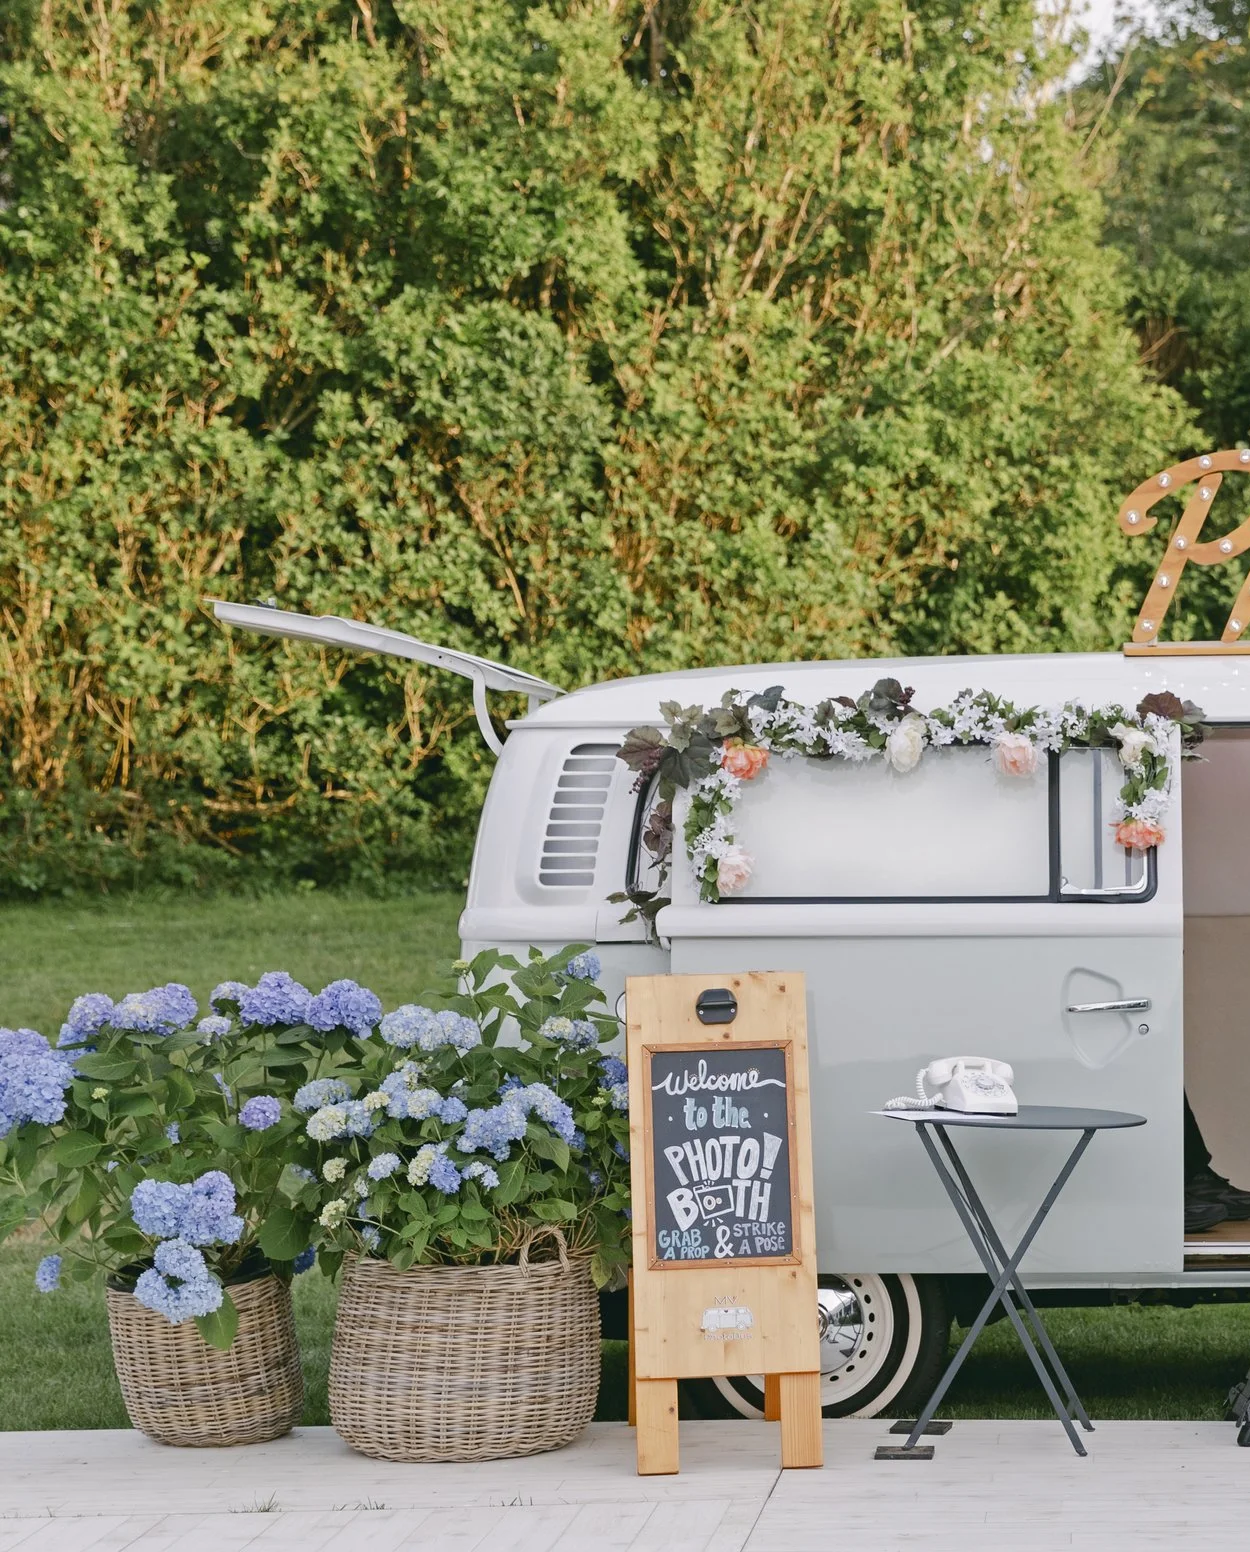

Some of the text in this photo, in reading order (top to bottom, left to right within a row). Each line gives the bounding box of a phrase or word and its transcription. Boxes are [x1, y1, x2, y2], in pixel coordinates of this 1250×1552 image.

[651, 1059, 786, 1096] Welcome
[684, 1095, 751, 1131] to the
[663, 1132, 783, 1186] PHOTO!
[658, 1229, 702, 1249] GRAB
[663, 1245, 710, 1260] A PROP
[738, 1239, 752, 1254] A
